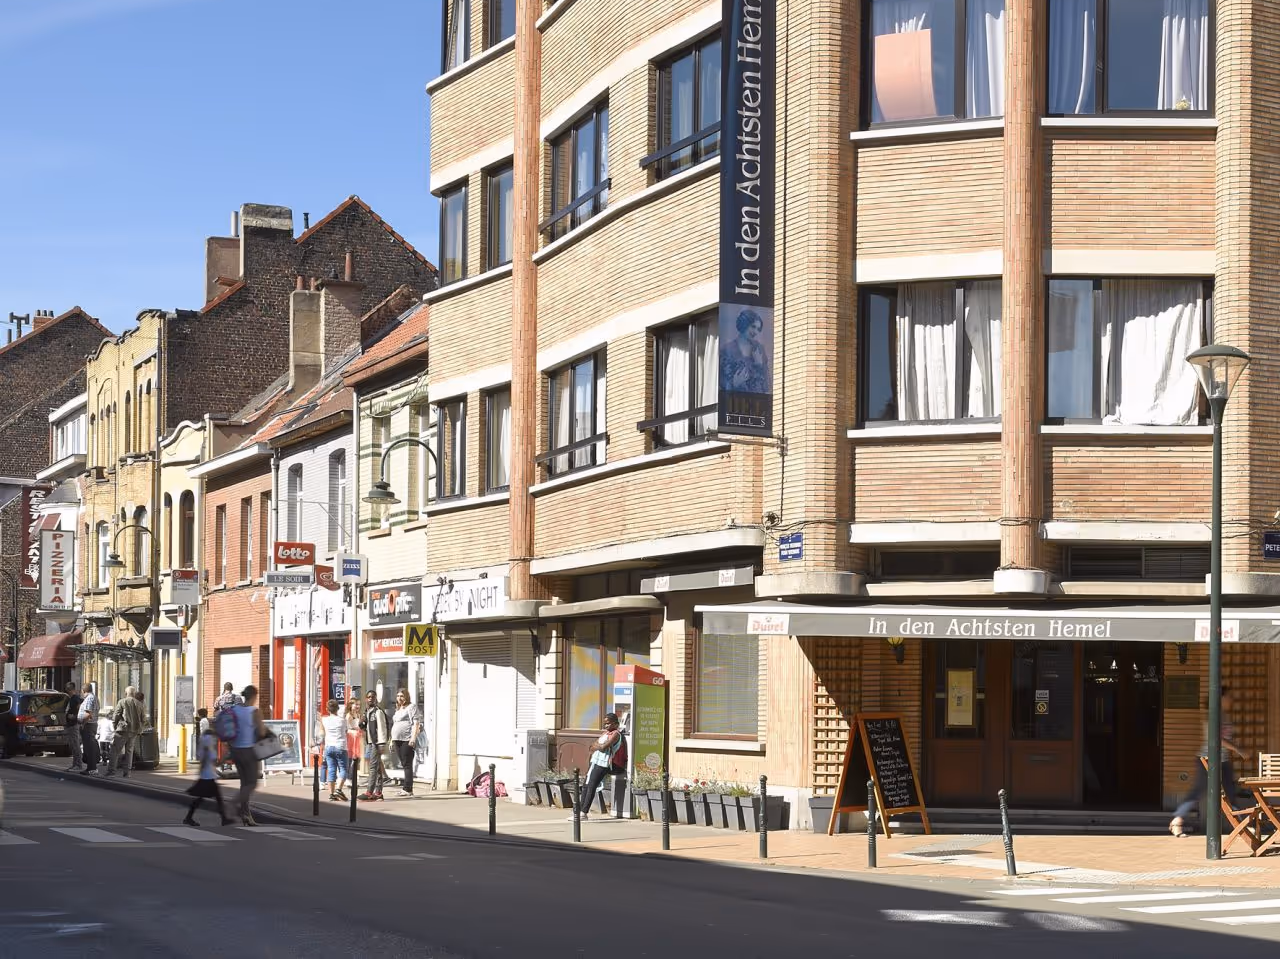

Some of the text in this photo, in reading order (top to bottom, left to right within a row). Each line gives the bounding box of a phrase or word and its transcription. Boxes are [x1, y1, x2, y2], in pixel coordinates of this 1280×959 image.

[735, 72, 762, 203] Achtsten
[735, 205, 760, 263] den
[735, 267, 760, 298] In
[726, 415, 766, 426] PILS
[50, 533, 64, 604] PIZZERIA
[469, 585, 499, 610] NIGHT
[751, 620, 784, 632] Duvel
[868, 617, 1111, 638] In den Achtsten Hemel
[1200, 626, 1234, 639] Del
[407, 645, 434, 655] POST
[652, 677, 664, 685] GO
